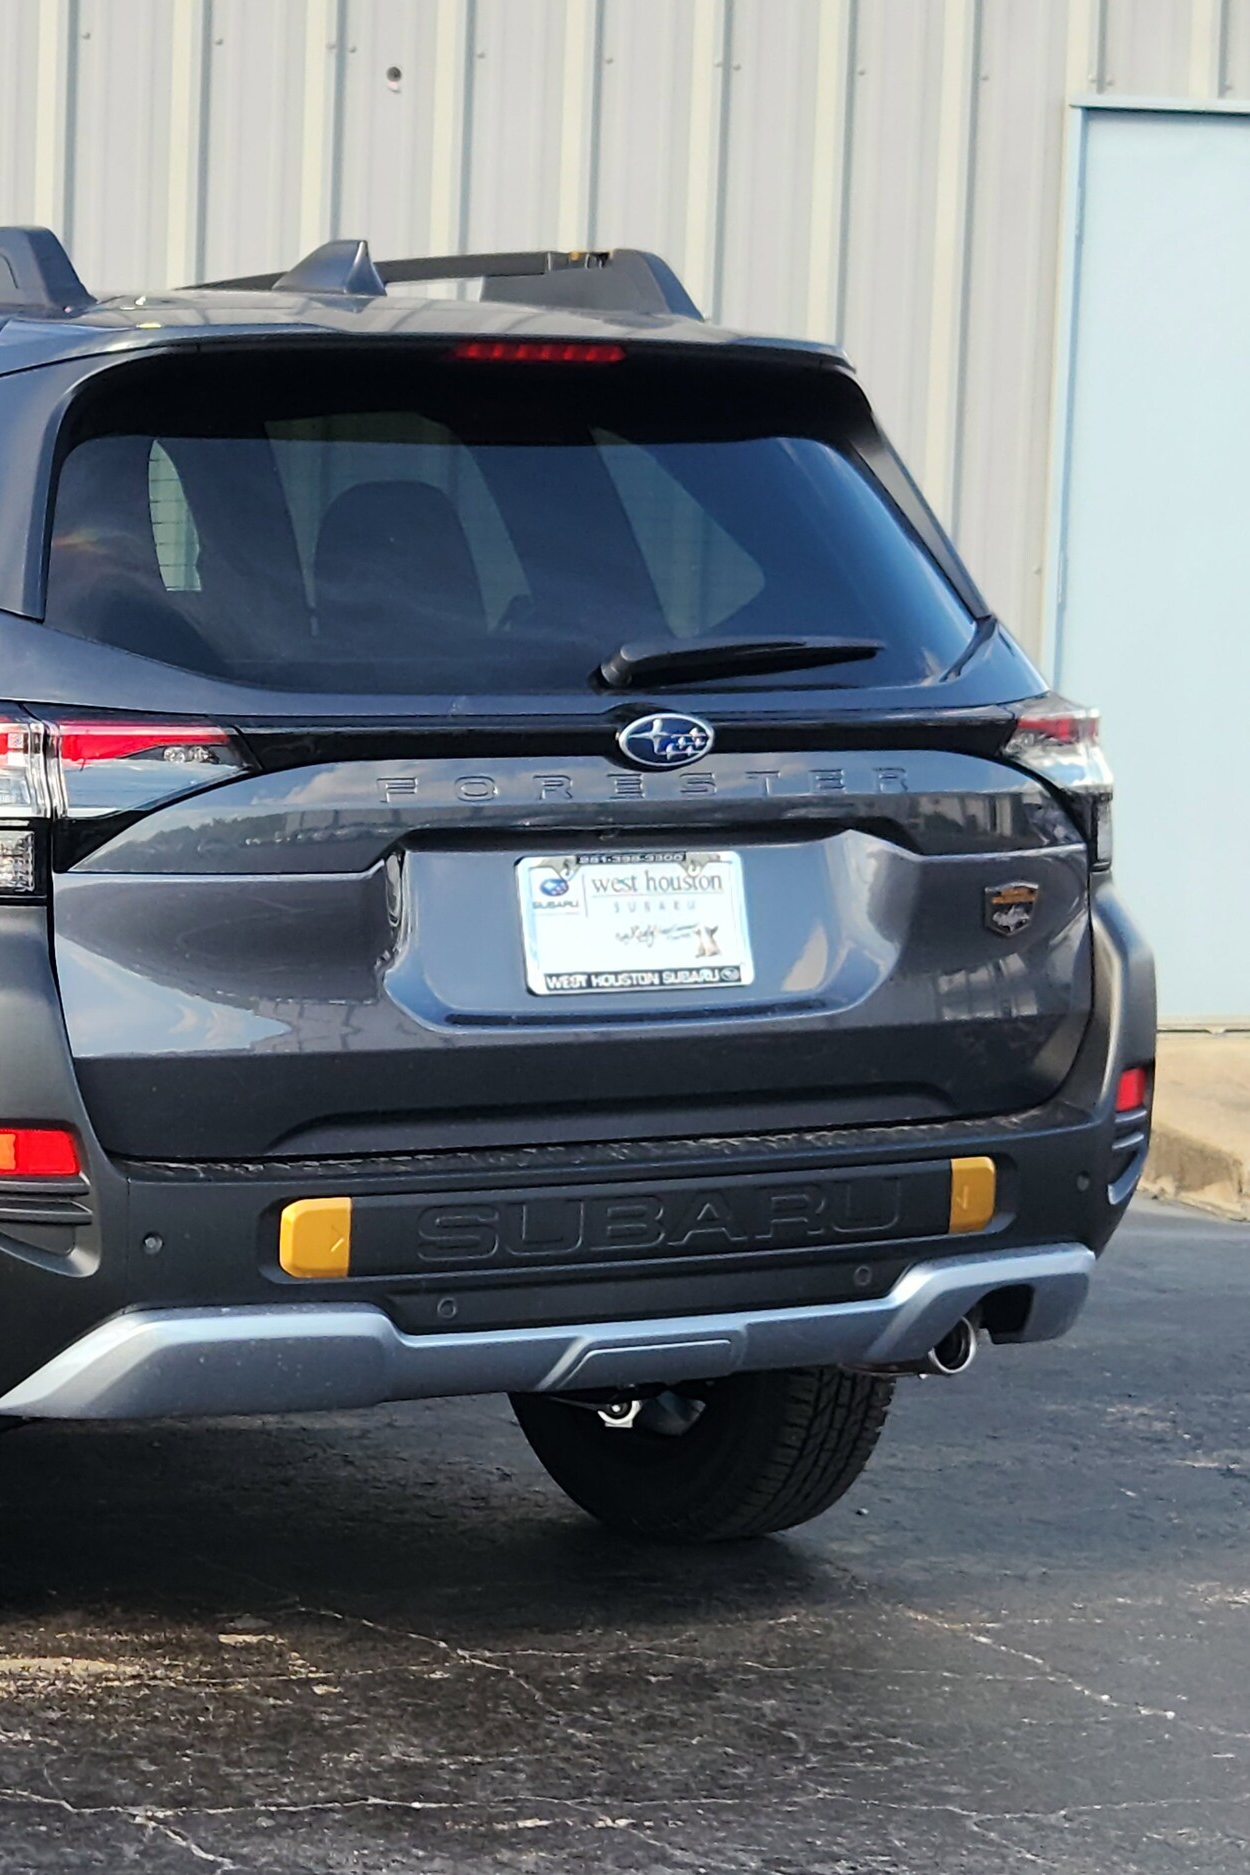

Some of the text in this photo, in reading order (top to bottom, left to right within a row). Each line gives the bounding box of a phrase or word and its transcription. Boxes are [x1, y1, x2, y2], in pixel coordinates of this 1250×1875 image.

[376, 767, 909, 802] FORESTER
[592, 869, 723, 894] west houston
[613, 900, 697, 914] SUBARU
[546, 967, 720, 990] WEST HOUSTON SUBARU
[417, 1176, 901, 1262] SUBARU
